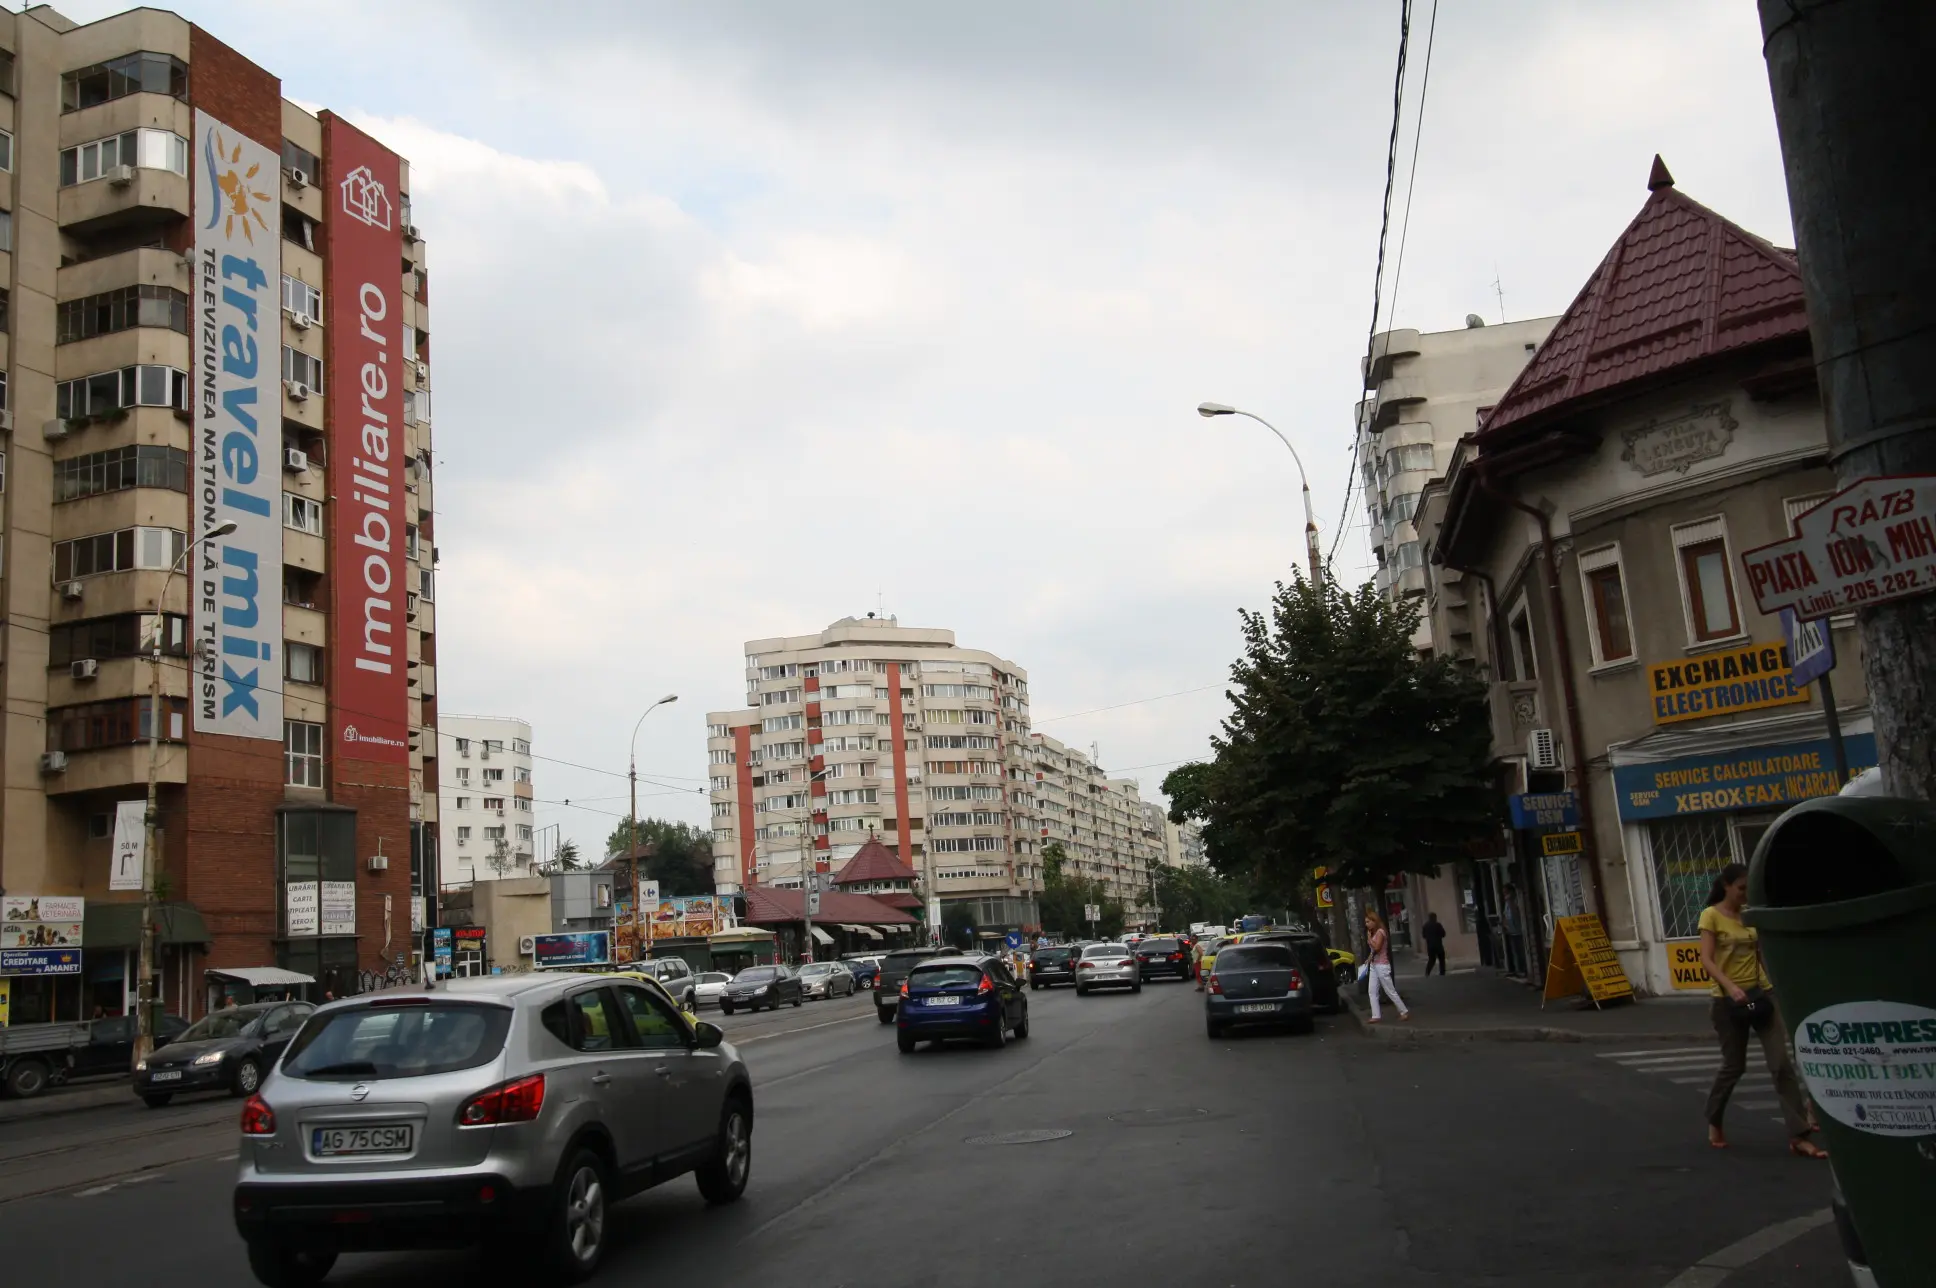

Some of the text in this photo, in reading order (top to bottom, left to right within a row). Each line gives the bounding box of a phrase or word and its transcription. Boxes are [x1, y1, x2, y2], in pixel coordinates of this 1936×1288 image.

[203, 248, 216, 420] TELEVIZIUNEA
[222, 254, 271, 722] travel mix
[353, 281, 392, 675] Imobiliare.ro
[1830, 488, 1915, 534] RATB
[1750, 513, 1936, 600] PIATA ION MIH
[203, 581, 216, 614] DE
[203, 621, 216, 721] TURISM
[1655, 674, 1799, 718] ELECTRONICE
[1654, 767, 1711, 789] SERVICE
[1713, 752, 1821, 782] CALCULATOARE
[1522, 795, 1573, 811] SERVICE
[1630, 790, 1660, 800] SERVICE
[1536, 809, 1564, 824] GSM
[3, 957, 48, 966] CREDITARE
[44, 963, 79, 973] AMANET
[1802, 1061, 1878, 1080] SECTORUL
[323, 1132, 344, 1149] AG
